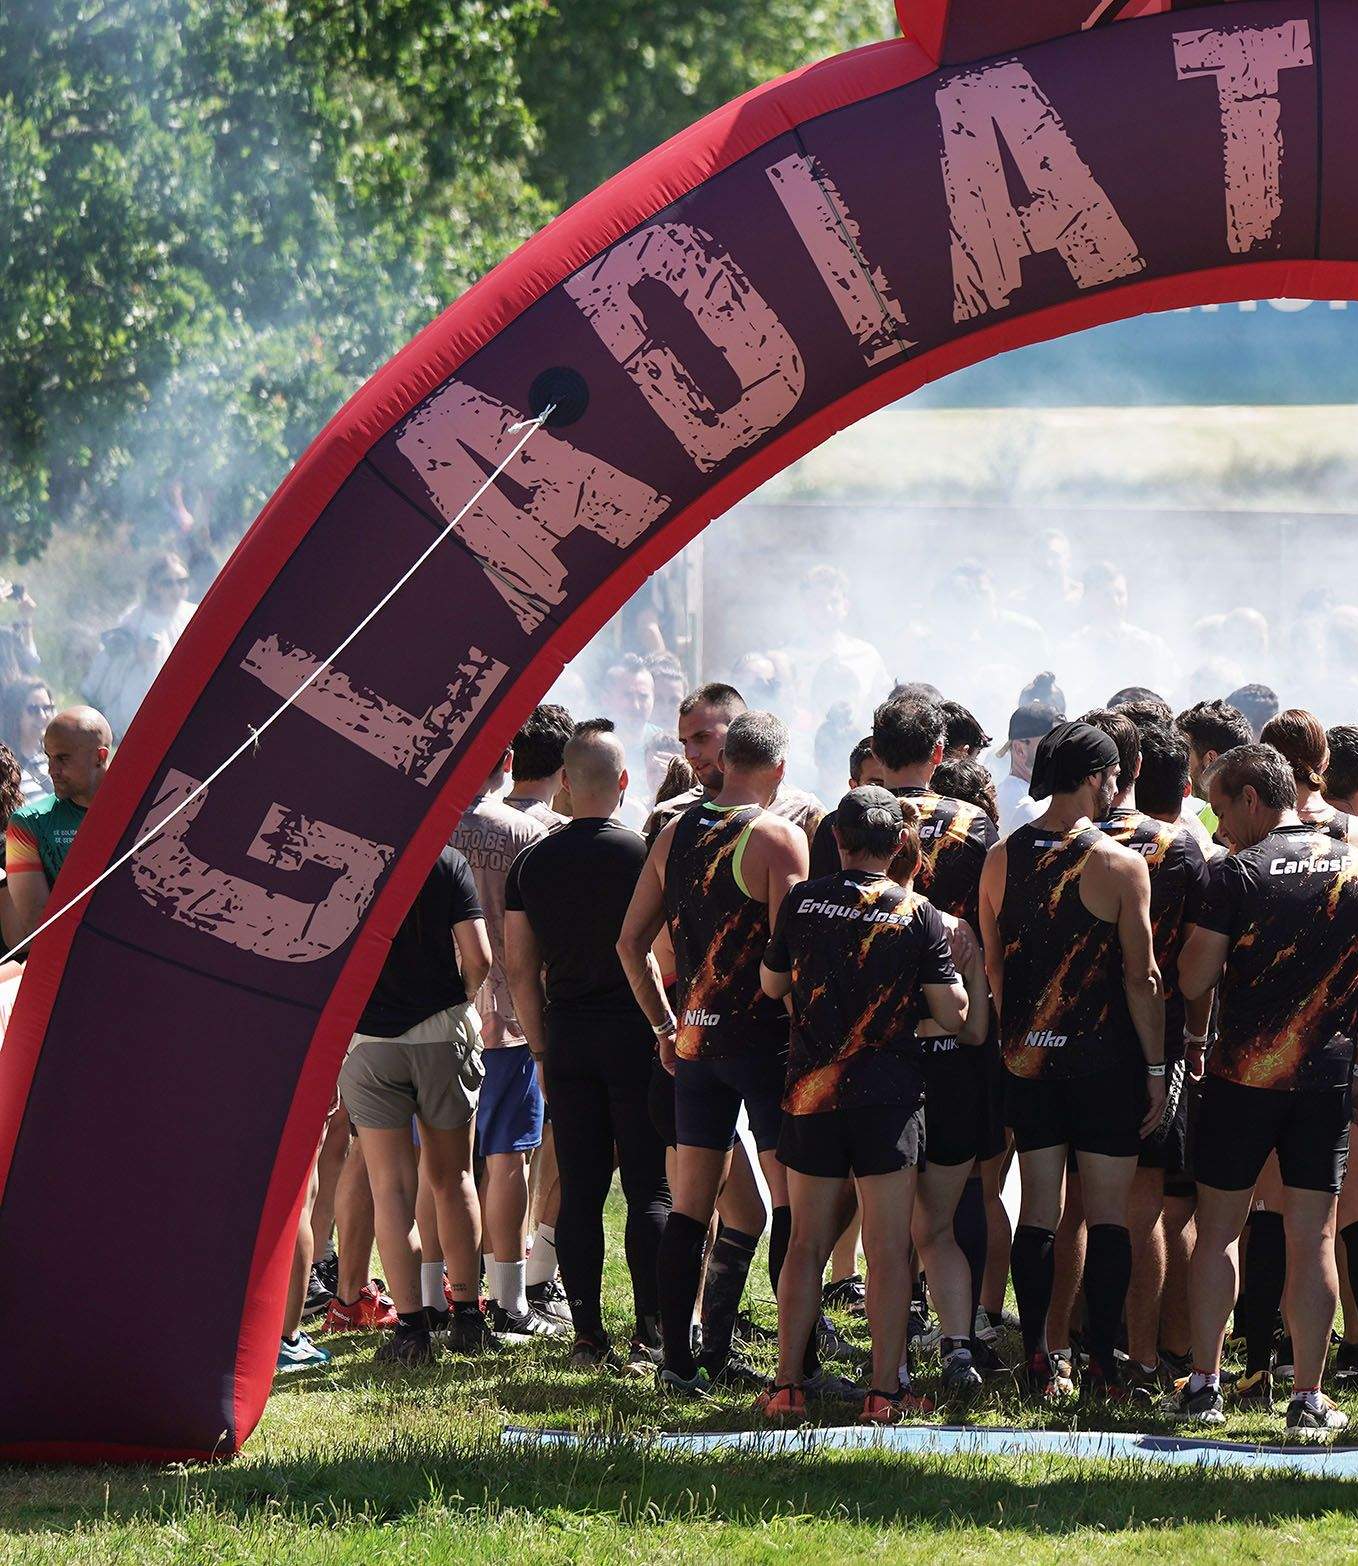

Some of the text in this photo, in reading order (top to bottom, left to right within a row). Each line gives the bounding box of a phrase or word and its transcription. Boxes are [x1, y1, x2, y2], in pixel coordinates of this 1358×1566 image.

[683, 1007, 721, 1027] Niko
[932, 1037, 961, 1053] NIK
[1023, 1030, 1068, 1048] Niko
